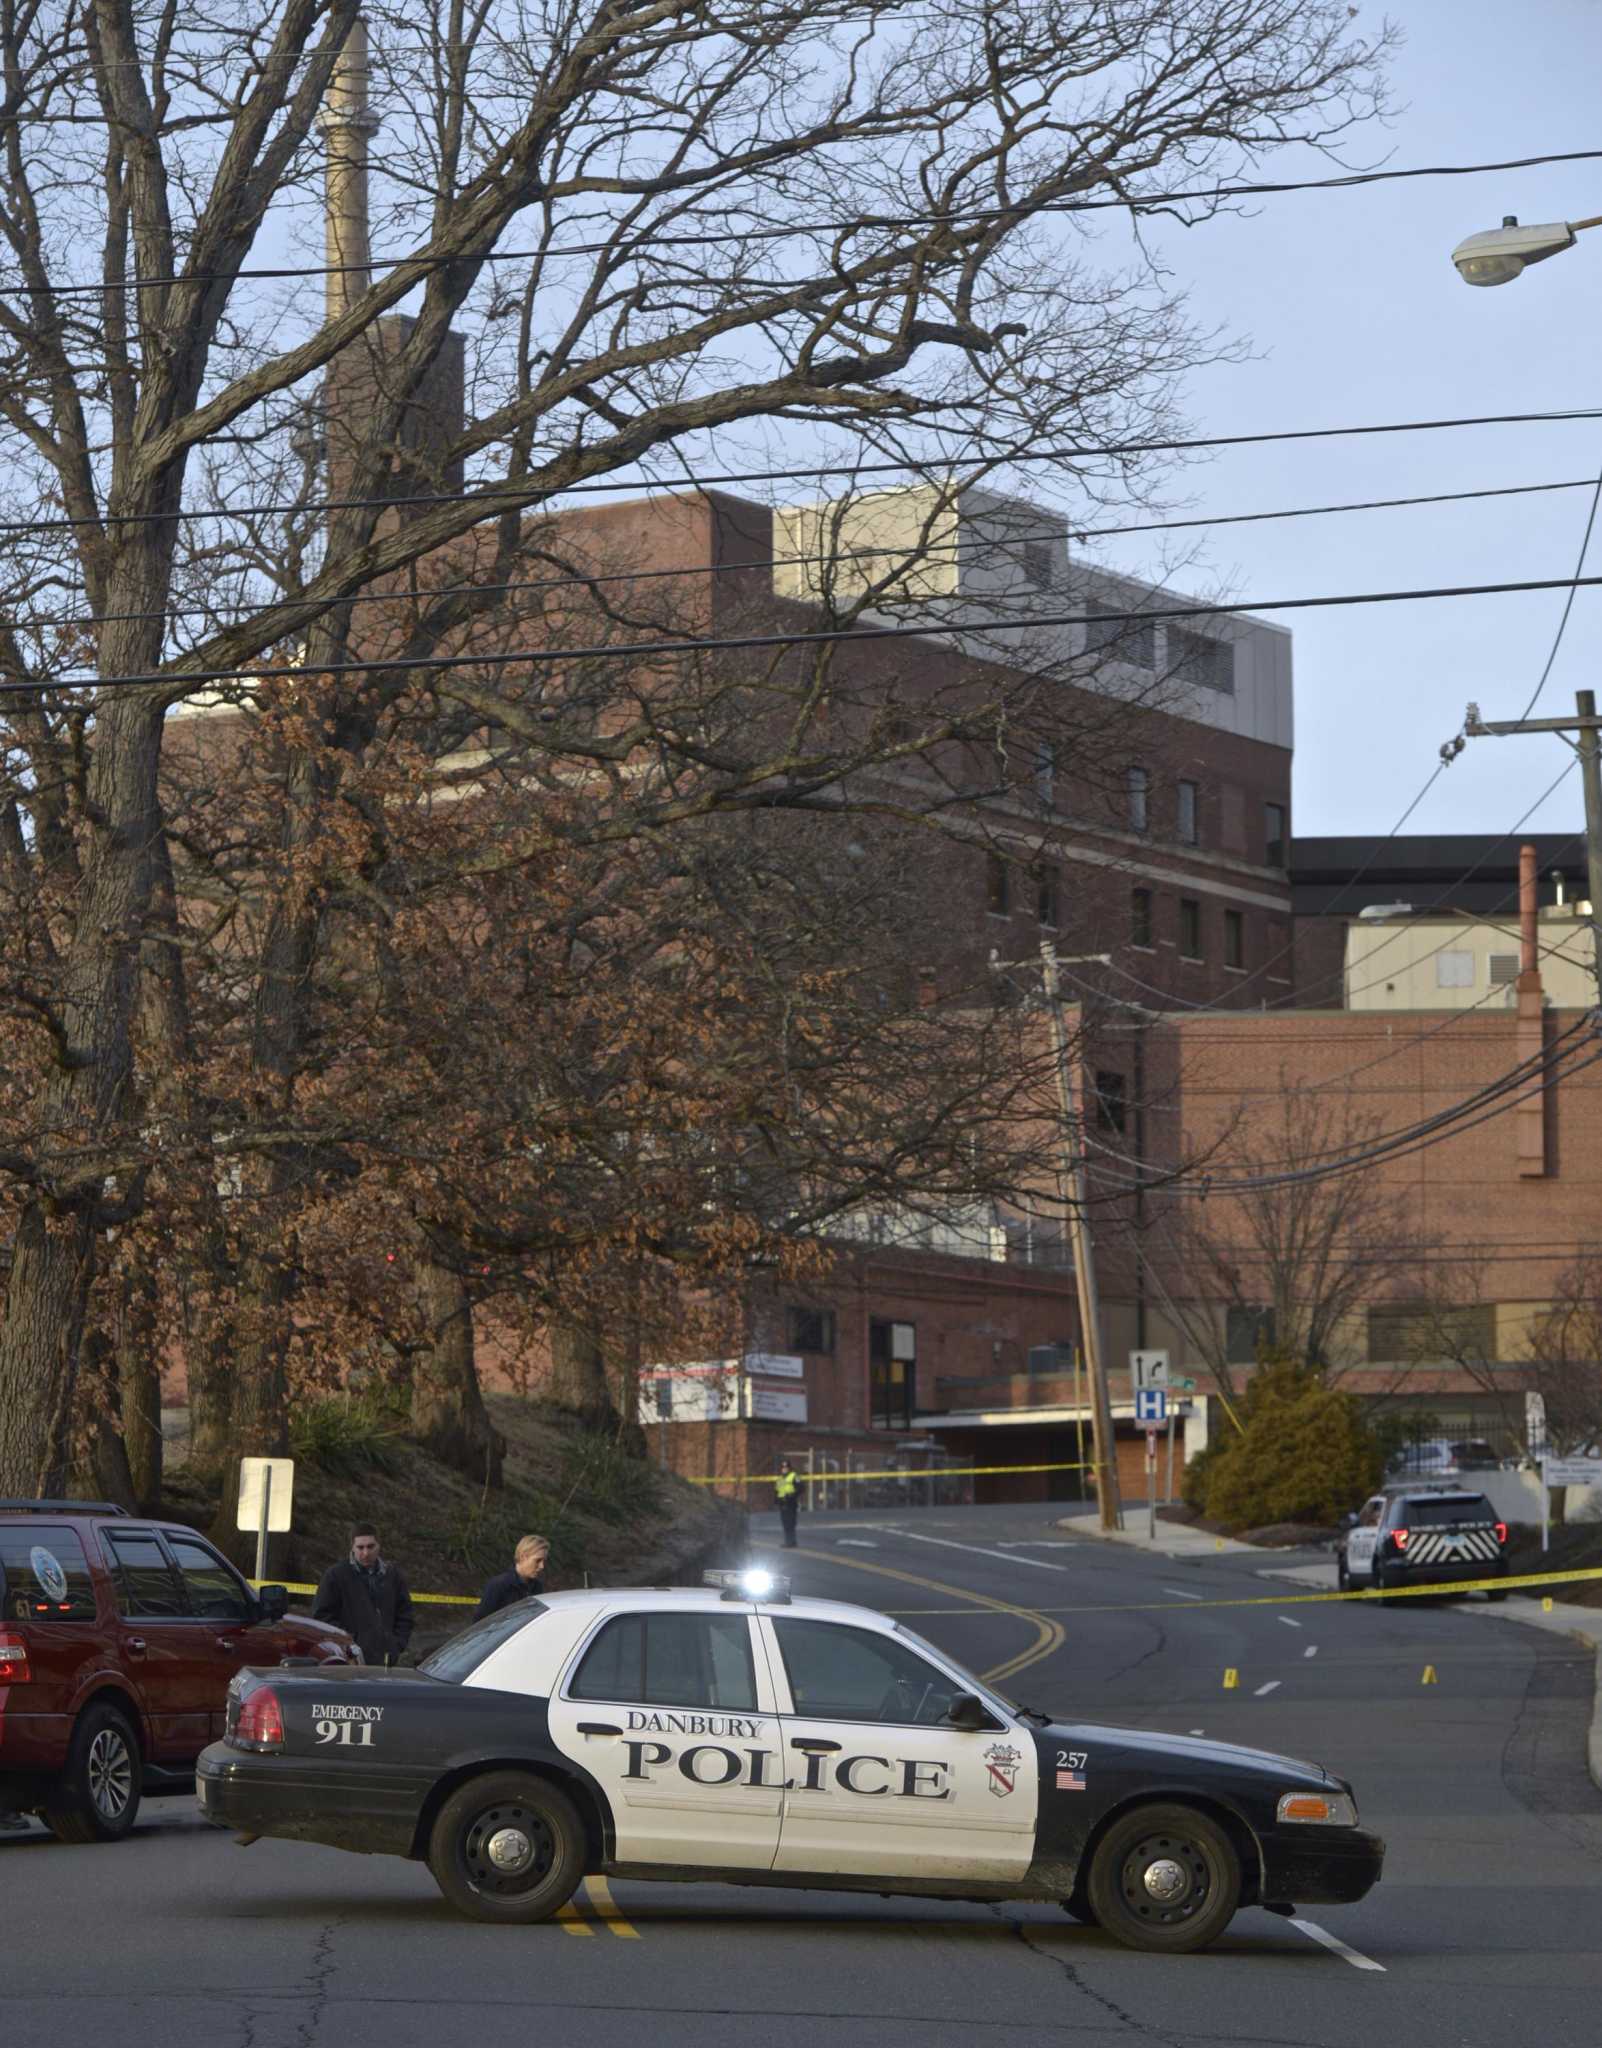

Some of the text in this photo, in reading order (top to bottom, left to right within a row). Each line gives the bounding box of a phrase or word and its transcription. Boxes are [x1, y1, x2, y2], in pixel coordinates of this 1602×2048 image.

[1139, 1391, 1163, 1419] H
[311, 1703, 385, 1721] EMERGENCY
[625, 1710, 764, 1738] DANBURY
[314, 1720, 377, 1747] 911
[620, 1739, 955, 1801] POLICE
[1056, 1750, 1089, 1769] 257
